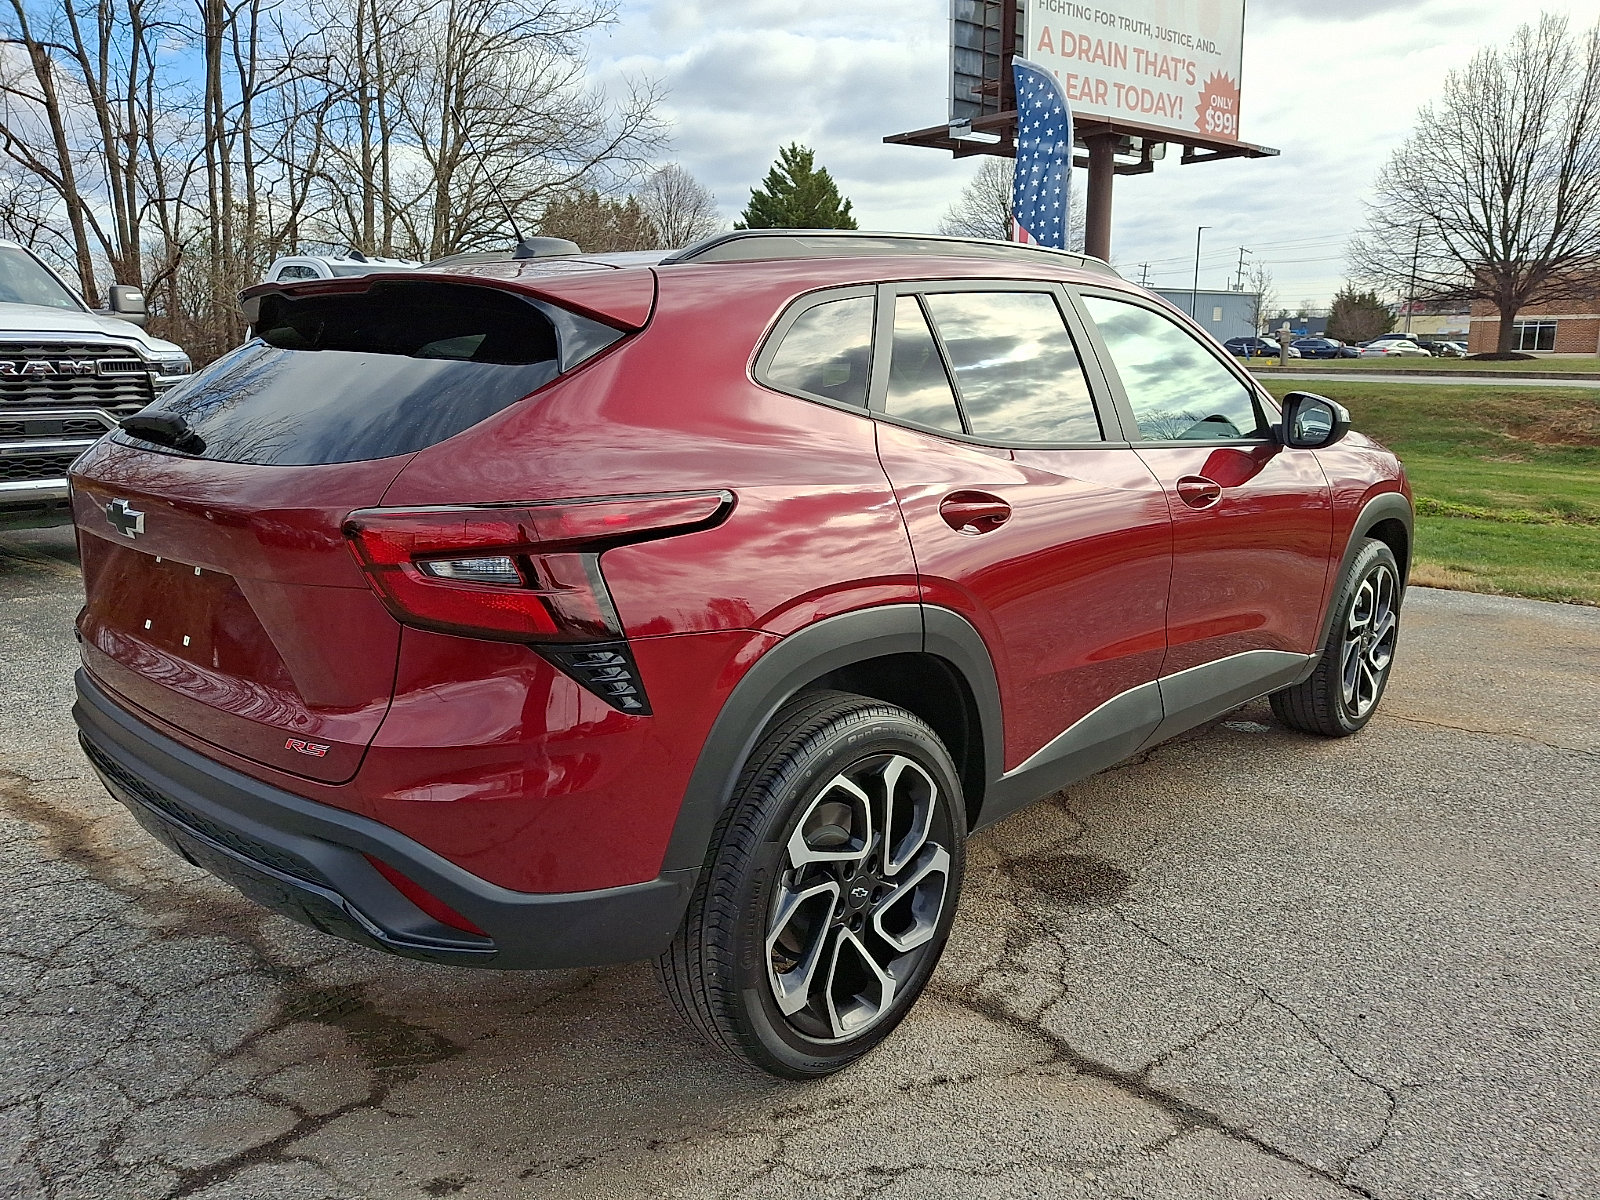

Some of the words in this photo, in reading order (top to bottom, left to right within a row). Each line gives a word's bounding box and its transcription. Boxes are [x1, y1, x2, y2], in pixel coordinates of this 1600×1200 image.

[1039, 0, 1091, 21] FIGHTING
[1094, 9, 1116, 28] FOR
[1118, 16, 1153, 40] TRUTH,
[1155, 26, 1194, 50] JUSTICE,
[1196, 38, 1222, 56] AND...
[1037, 25, 1055, 54] A
[1061, 30, 1128, 70] DRAIN
[1133, 47, 1197, 86] THAT'S
[1055, 70, 1108, 106] EAR
[1113, 82, 1183, 120] TODAY!
[1210, 94, 1233, 110] ONLY
[1205, 106, 1237, 135] $99!
[284, 738, 330, 757] RS
